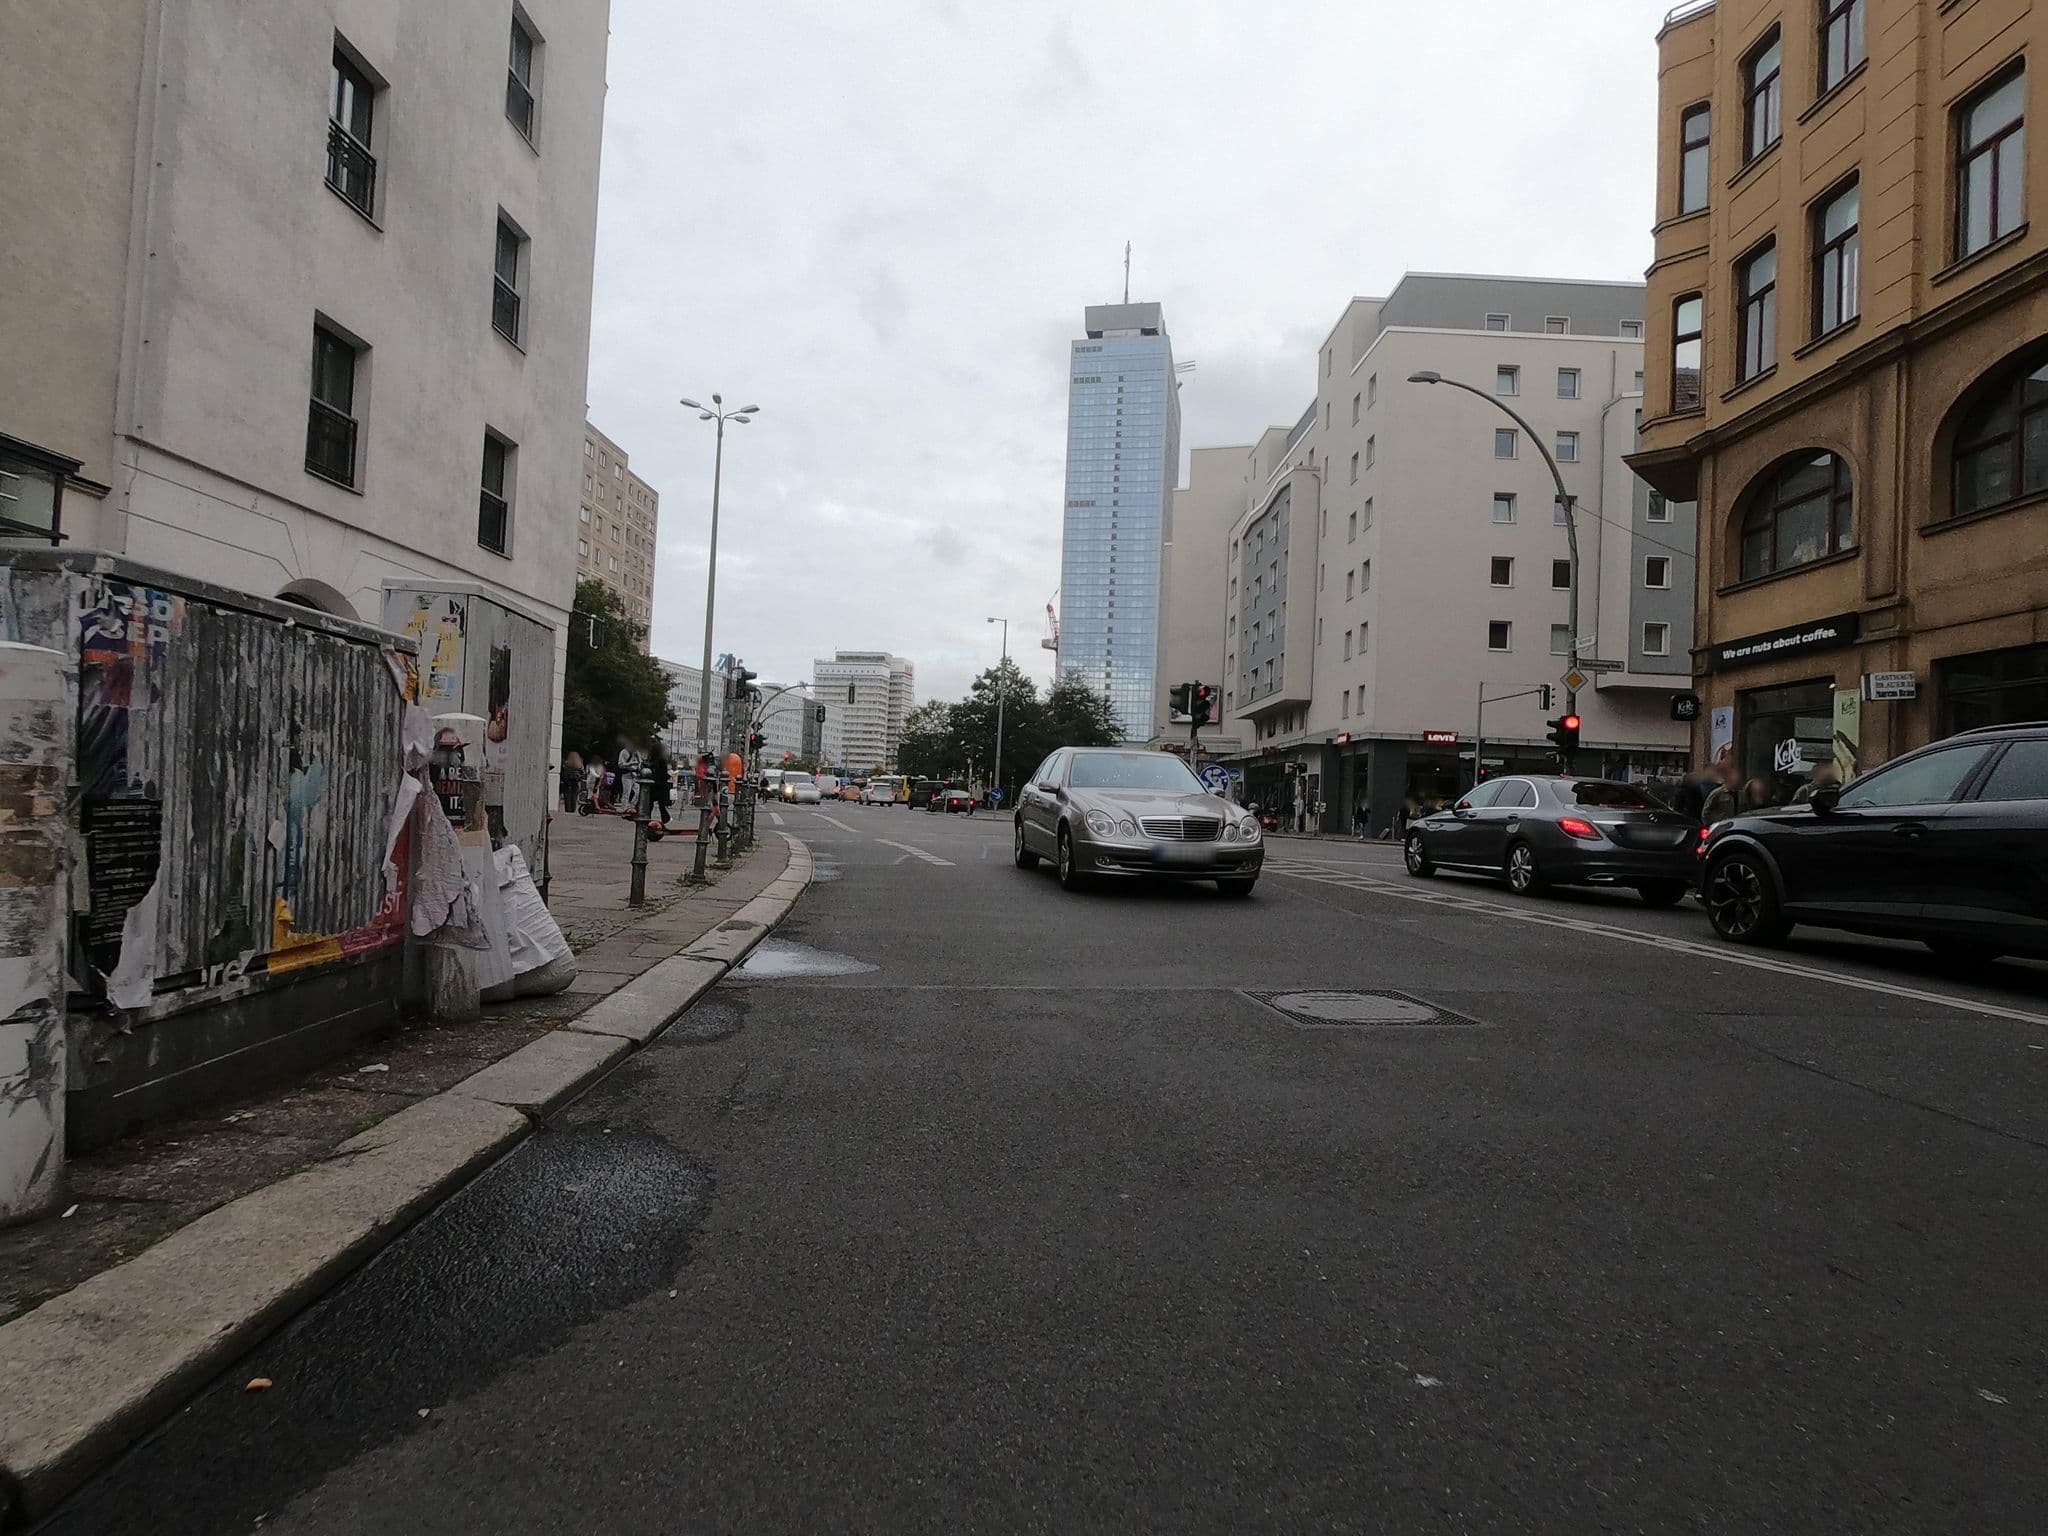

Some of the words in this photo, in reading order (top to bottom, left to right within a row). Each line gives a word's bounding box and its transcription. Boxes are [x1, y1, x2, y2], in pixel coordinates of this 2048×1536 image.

[1722, 649, 1735, 660] We
[1736, 646, 1751, 657] are
[1752, 642, 1772, 654] nuts
[1772, 635, 1801, 649] about
[1801, 627, 1838, 643] coffee.
